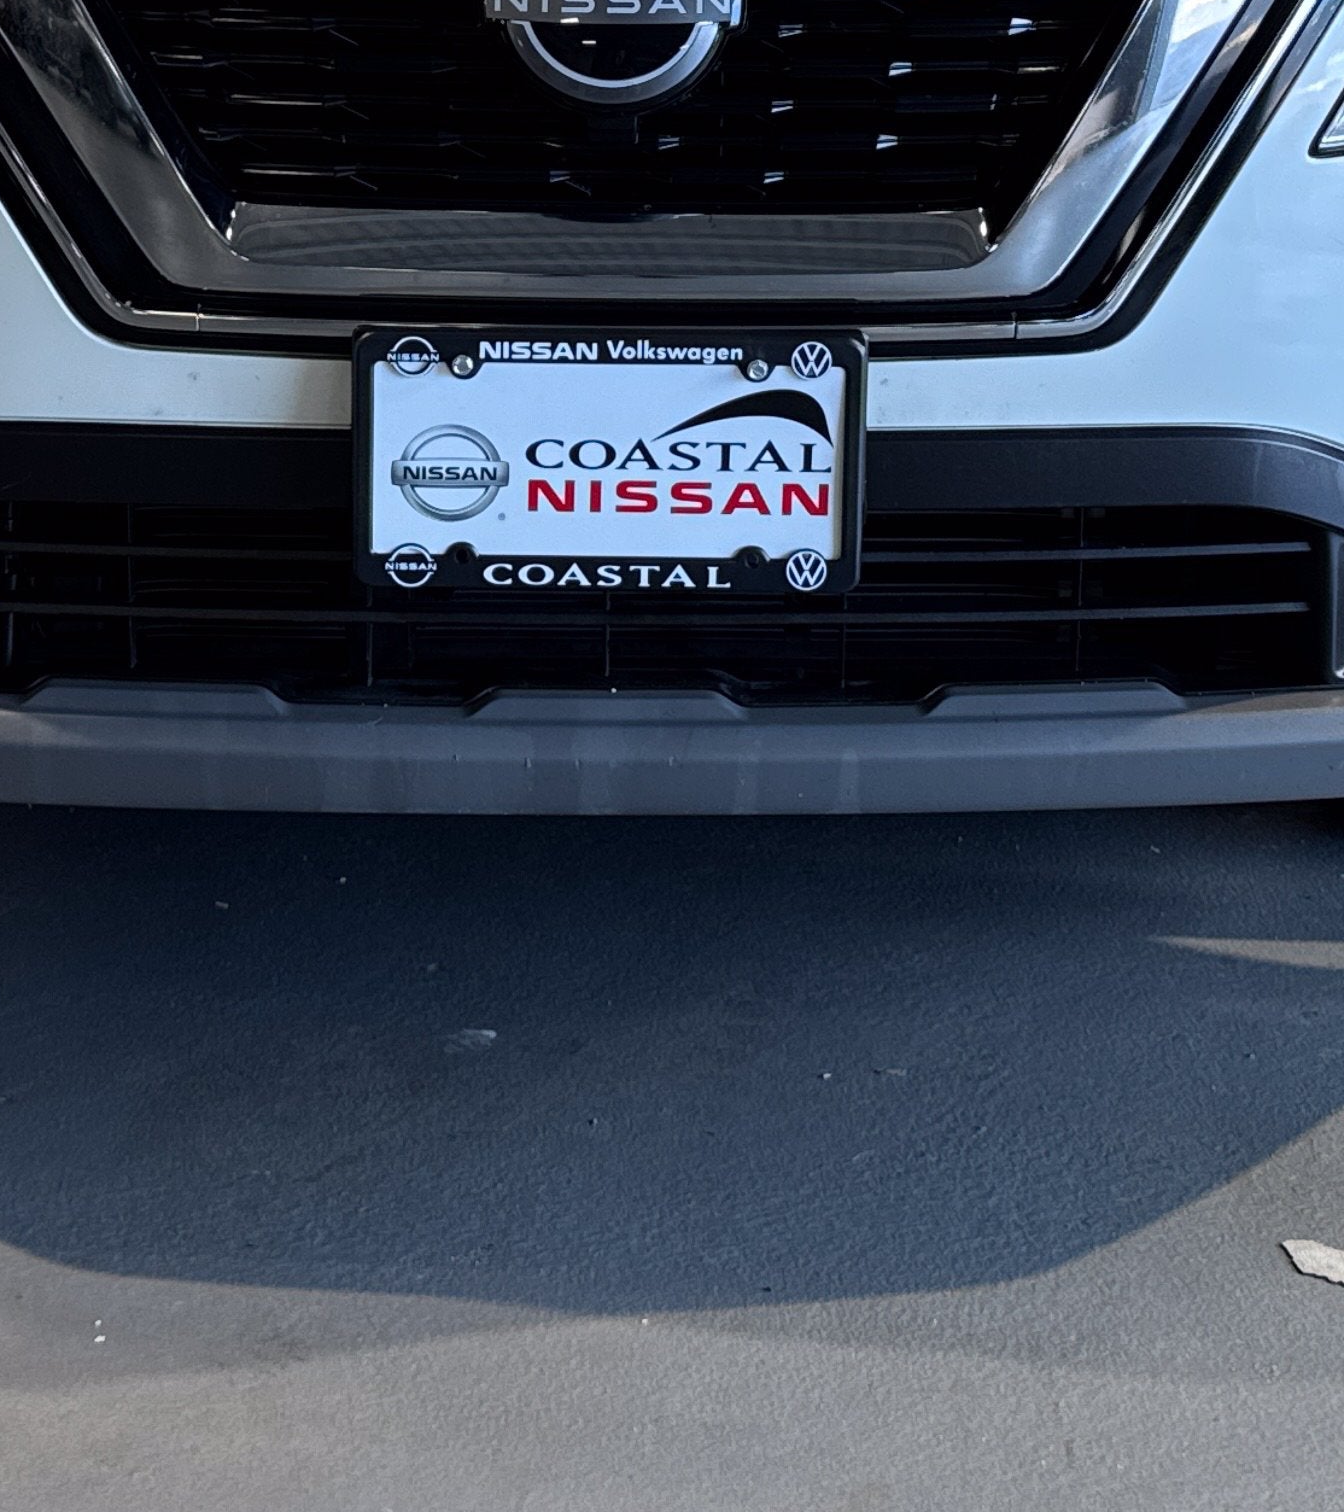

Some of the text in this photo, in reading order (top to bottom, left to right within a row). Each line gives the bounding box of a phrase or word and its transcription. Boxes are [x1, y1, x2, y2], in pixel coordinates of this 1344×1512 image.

[386, 351, 440, 362] NISSAN
[479, 340, 743, 364] NISSAN Volkswagen
[525, 438, 833, 474] COASTAL
[403, 465, 498, 482] NISSAN
[527, 479, 829, 516] NISSAN
[384, 561, 438, 572] NISSAN
[482, 562, 731, 588] COASTAL
